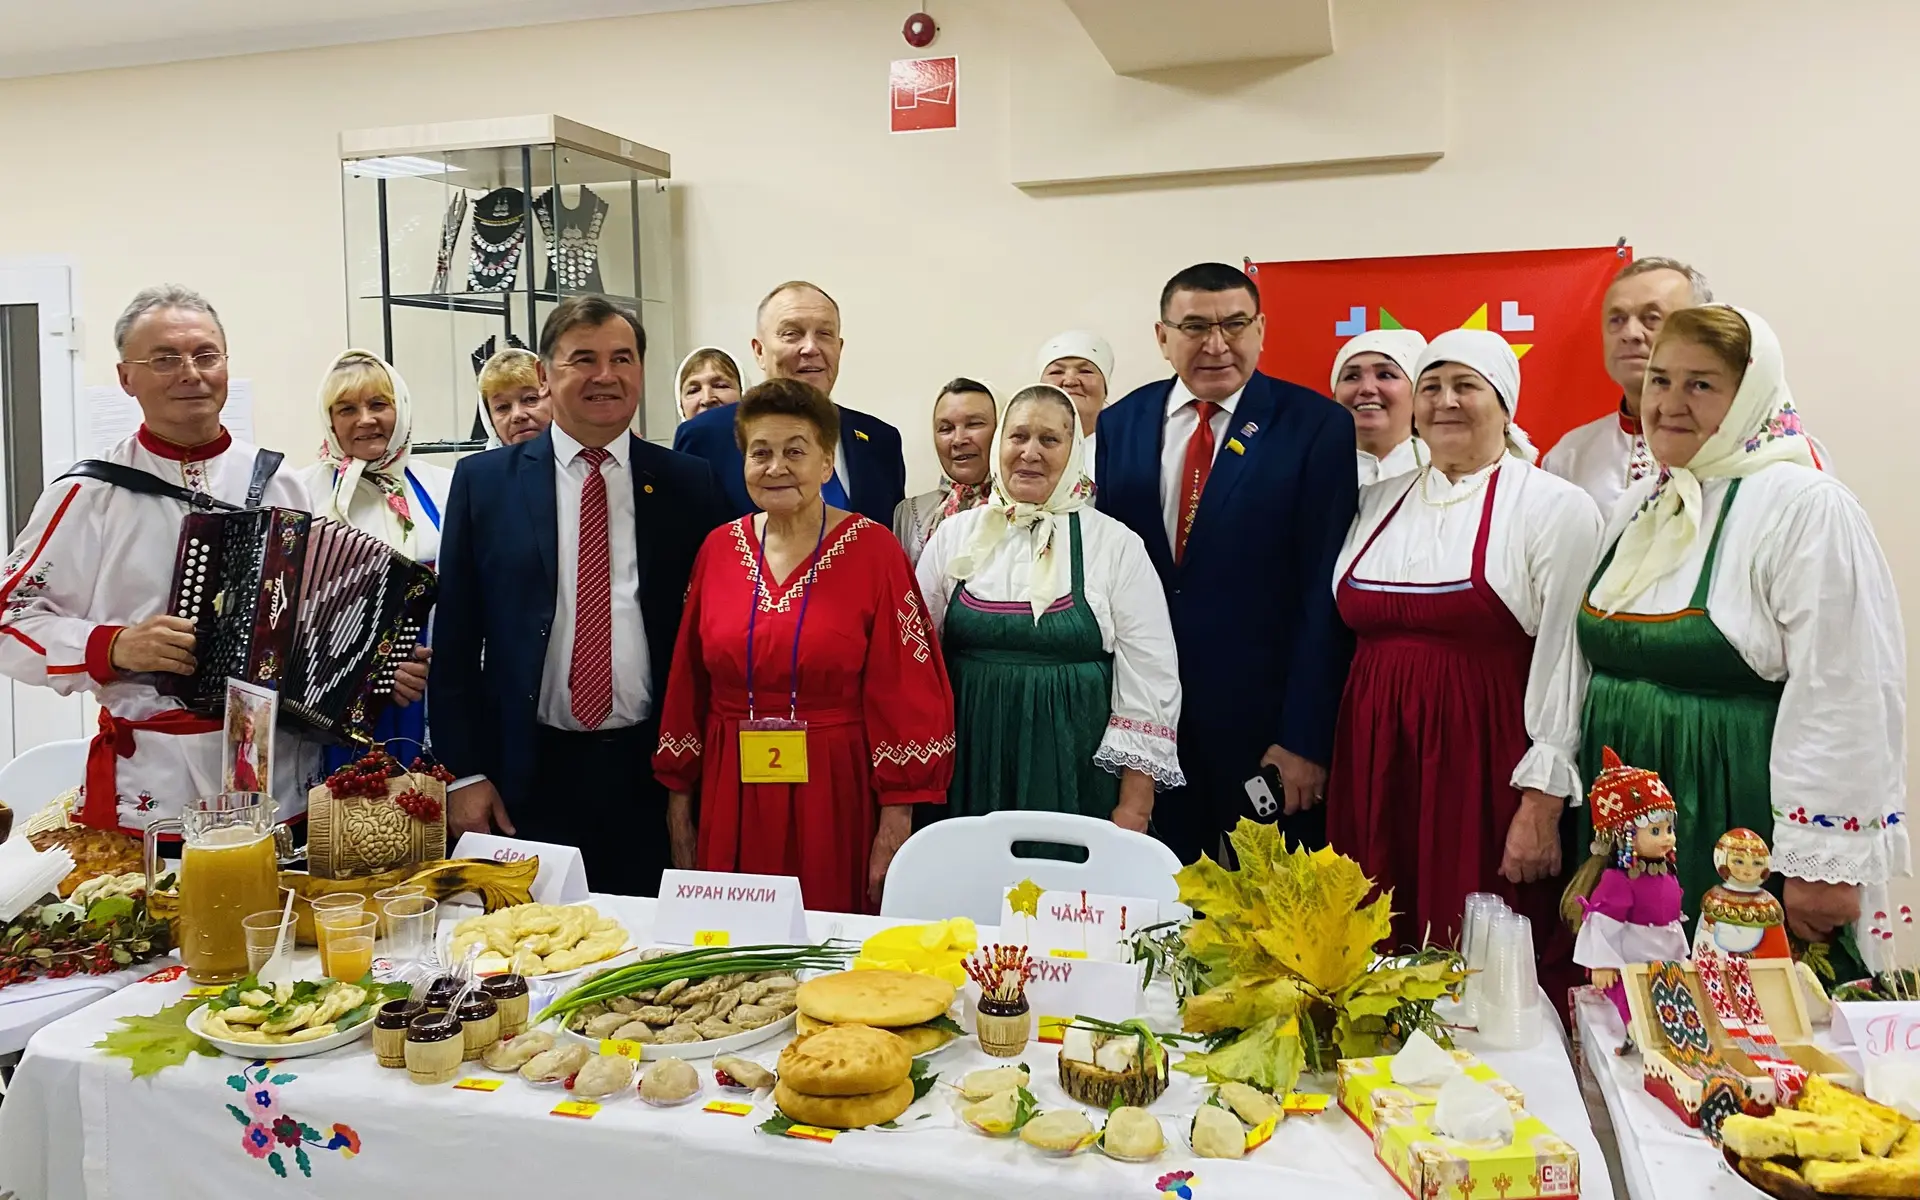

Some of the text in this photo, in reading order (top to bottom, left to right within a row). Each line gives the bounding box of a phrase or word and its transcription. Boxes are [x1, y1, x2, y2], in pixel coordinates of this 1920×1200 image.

[768, 747, 782, 768] 2
[676, 884, 776, 903] ХУРАН КУКЛИ
